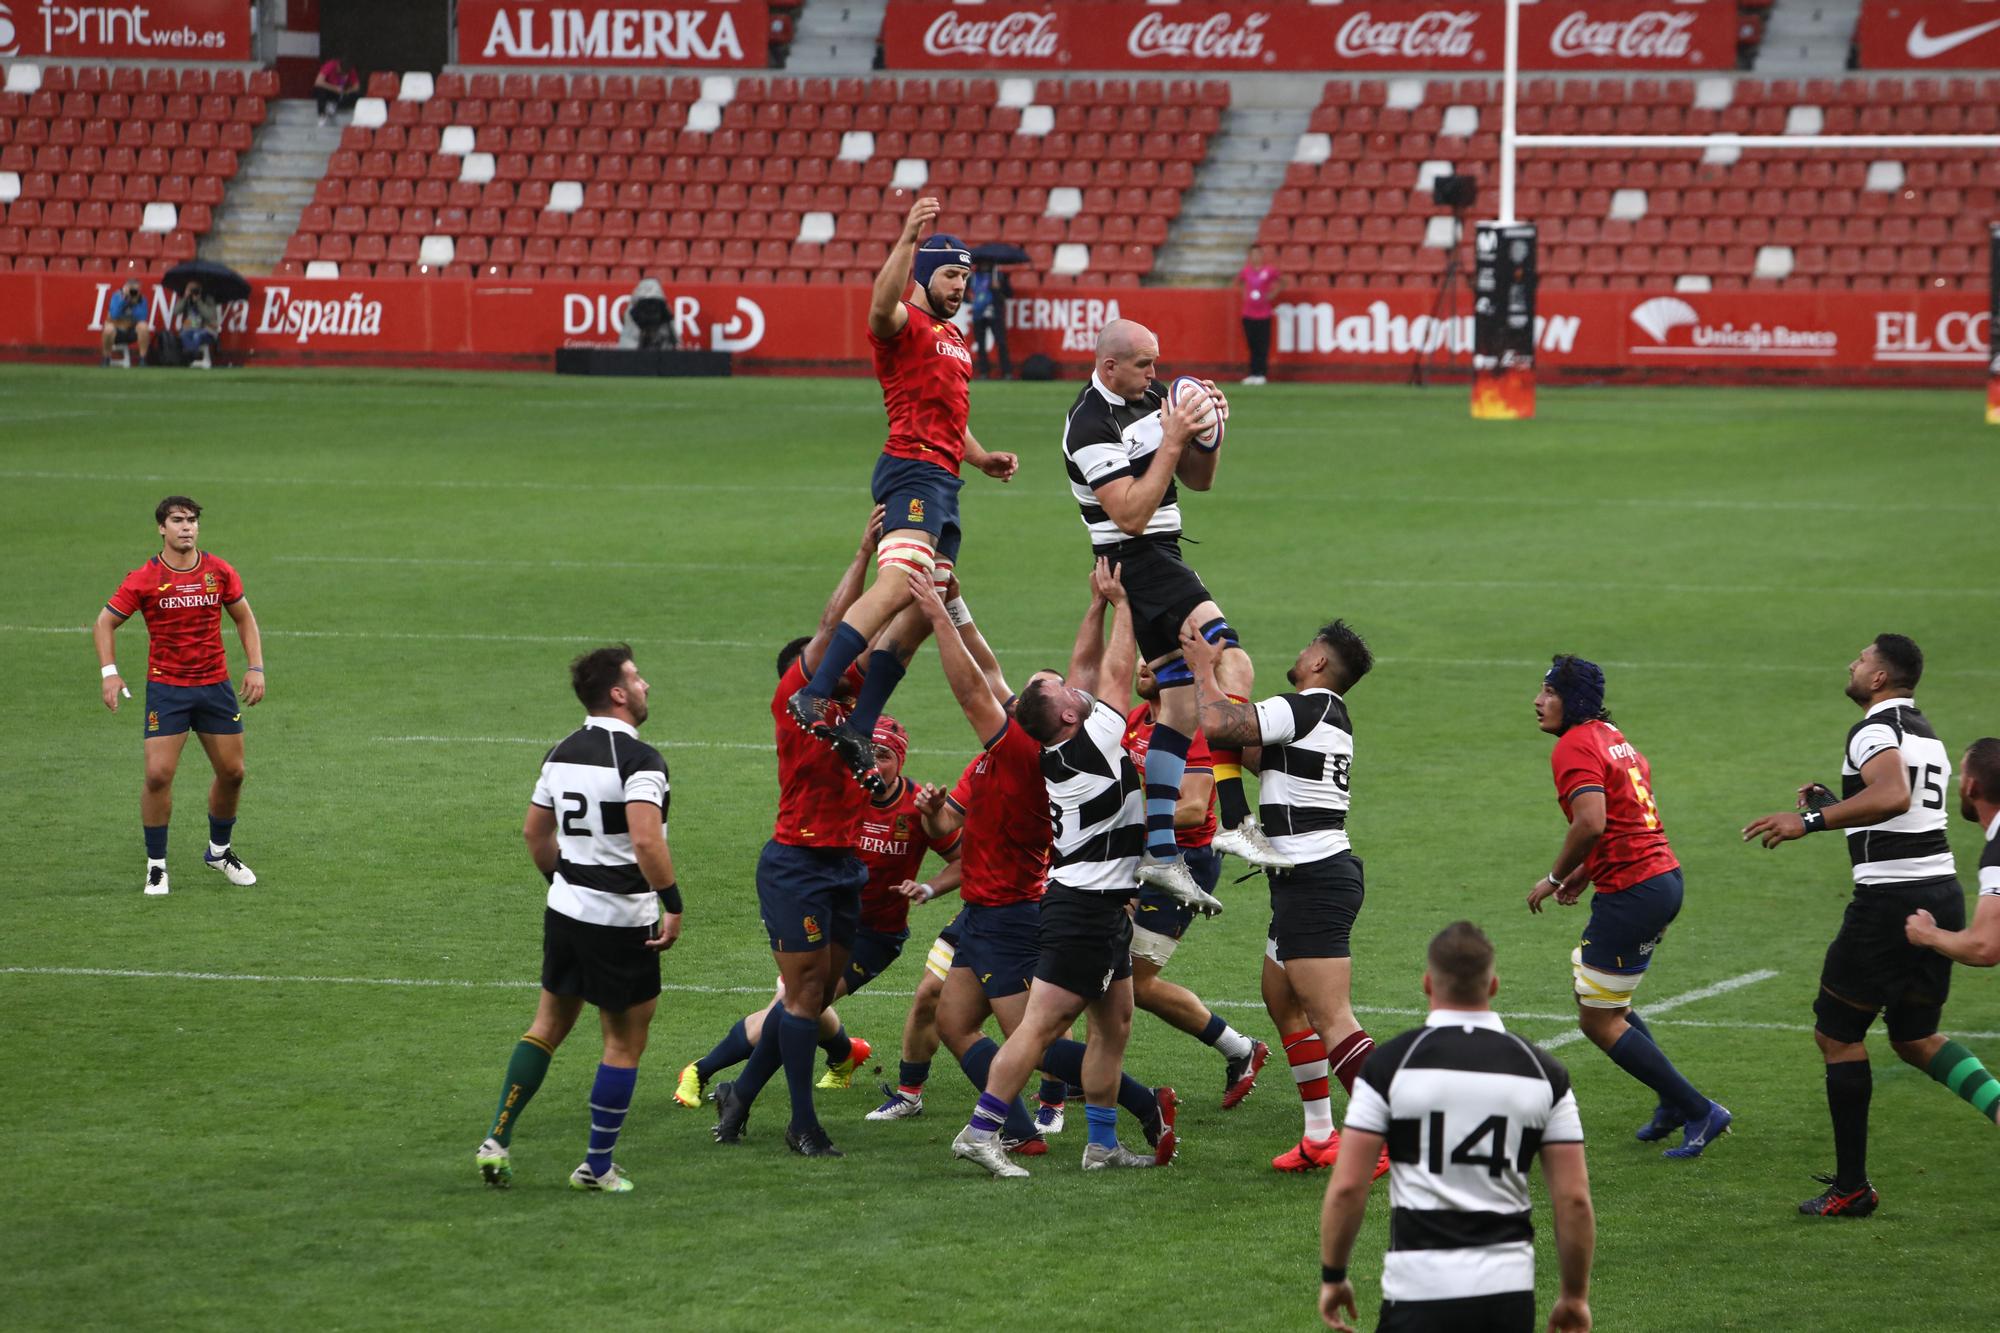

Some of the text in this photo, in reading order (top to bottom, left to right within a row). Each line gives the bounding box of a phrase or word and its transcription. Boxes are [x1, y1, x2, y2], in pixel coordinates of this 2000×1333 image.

[482, 9, 744, 59] ALIMERKA
[923, 11, 1058, 58] Coca-Cola
[1335, 11, 1481, 58] Coca-Cola
[1550, 11, 1698, 58] Coca-Cola
[148, 284, 249, 333] Nva
[256, 286, 382, 343] España
[1005, 299, 1122, 329] TERNERA
[1276, 301, 1476, 353] Mahou
[1692, 322, 1838, 352] Unicaja Banco
[1875, 311, 1931, 350] EL
[159, 593, 220, 609] GENERALI
[562, 791, 593, 837] 2
[860, 835, 909, 855] ERALI
[1428, 1111, 1511, 1178] 14
